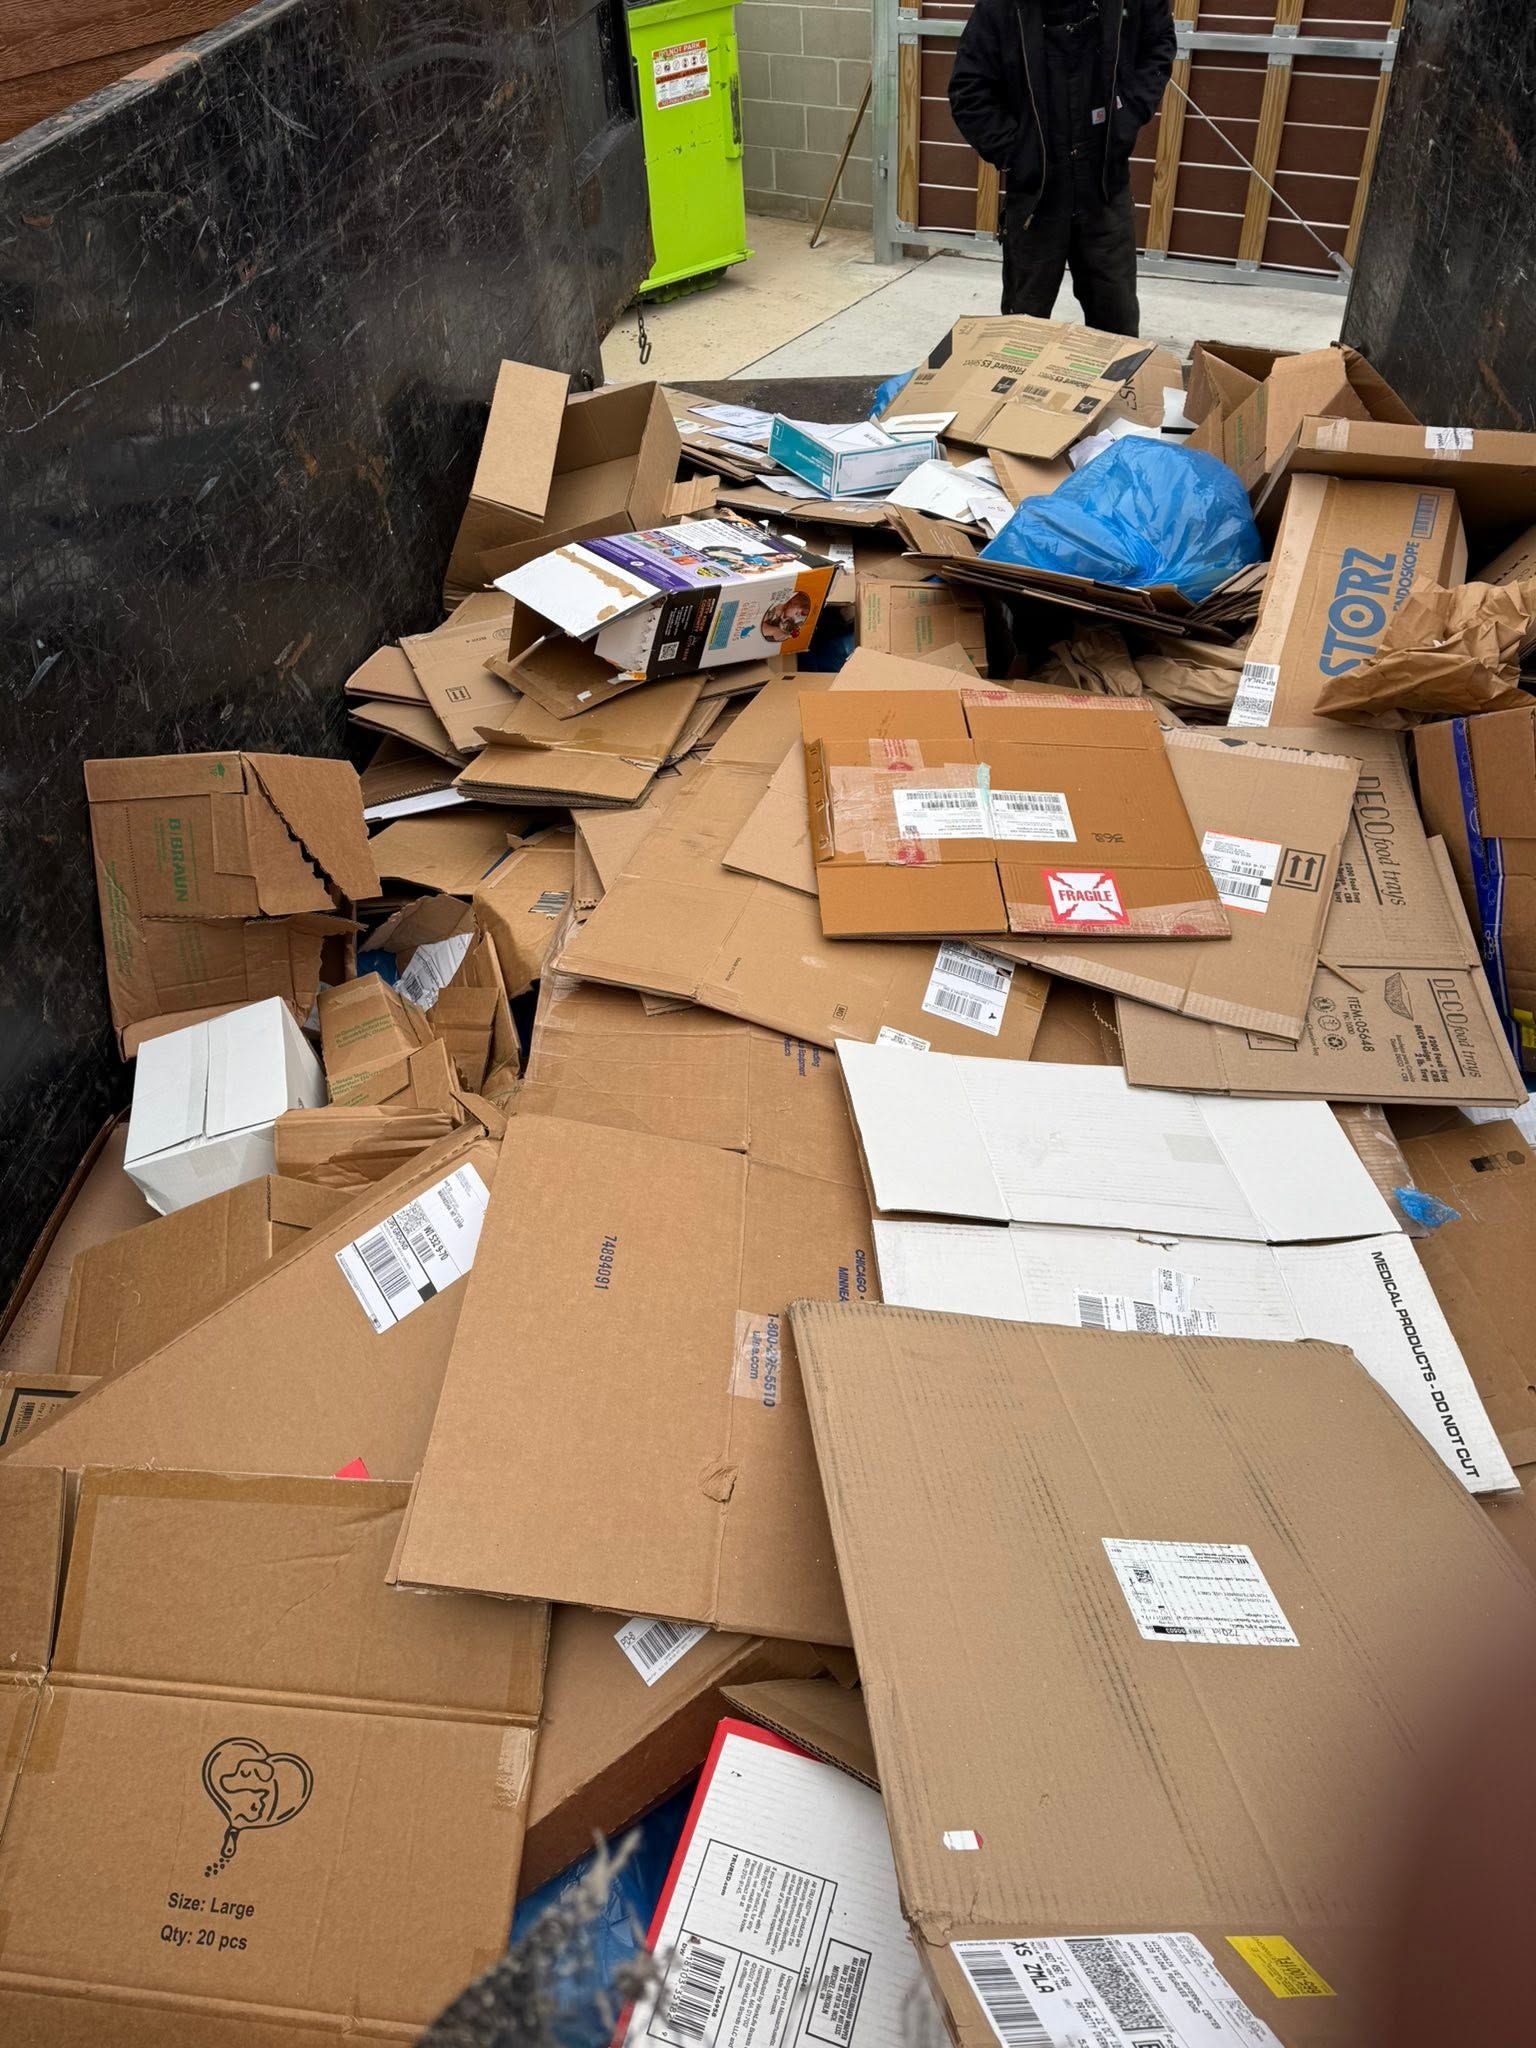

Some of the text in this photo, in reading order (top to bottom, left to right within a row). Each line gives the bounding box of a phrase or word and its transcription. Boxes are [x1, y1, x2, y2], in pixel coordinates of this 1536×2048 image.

[669, 41, 700, 54] NOT PARK
[981, 359, 992, 368] ES
[1316, 539, 1397, 676] STORZ
[1355, 775, 1406, 905] DECO food trays
[169, 837, 188, 902] BRAUN
[1348, 877, 1358, 890] Food
[1058, 889, 1112, 901] FRAGILE
[1351, 891, 1361, 902] Tray
[1346, 996, 1375, 1052] ITEM:05648
[1432, 977, 1482, 1078] DECO food trays
[1394, 1053, 1403, 1067] DECO
[1414, 1024, 1439, 1082] DECO Design CRB
[1416, 1058, 1425, 1066] lb.
[1433, 1052, 1445, 1067] Food
[1440, 1069, 1449, 1082] Tray
[1420, 1068, 1429, 1081] Tray
[385, 1217, 409, 1251] UPS GROUND
[423, 1225, 449, 1261] WI 532 9-70
[594, 1235, 617, 1289] 74894091
[855, 1249, 865, 1292] CHICAGO
[1371, 1250, 1403, 1307] MEDICAL
[1396, 1308, 1436, 1382] PRODUCTS
[1431, 1390, 1449, 1413] DO
[1440, 1413, 1464, 1446] NOT
[1456, 1447, 1479, 1478] CUT
[720, 1853, 738, 1896] TRURED.com
[168, 1892, 254, 1919] Size: Large
[160, 1924, 247, 1950] Qty: 20 pcs
[1011, 1941, 1055, 1994] XS ZMLA
[1126, 1943, 1147, 1964] WAUKESHA
[759, 1967, 771, 1995] Distributed
[777, 1972, 786, 1988] Made
[781, 1975, 793, 2000] Designed
[1150, 1941, 1174, 1966] WISCONSIN
[1180, 1982, 1203, 2006] REFERRAL
[1201, 2010, 1221, 2029] CENTER
[1165, 1974, 1200, 2013] PEWAUKEE ROAD
[711, 1985, 725, 2017] TR56958
[734, 2005, 744, 2025] Brands
[747, 1998, 754, 2009] MA
[1073, 2002, 1098, 2028] PRIORITY
